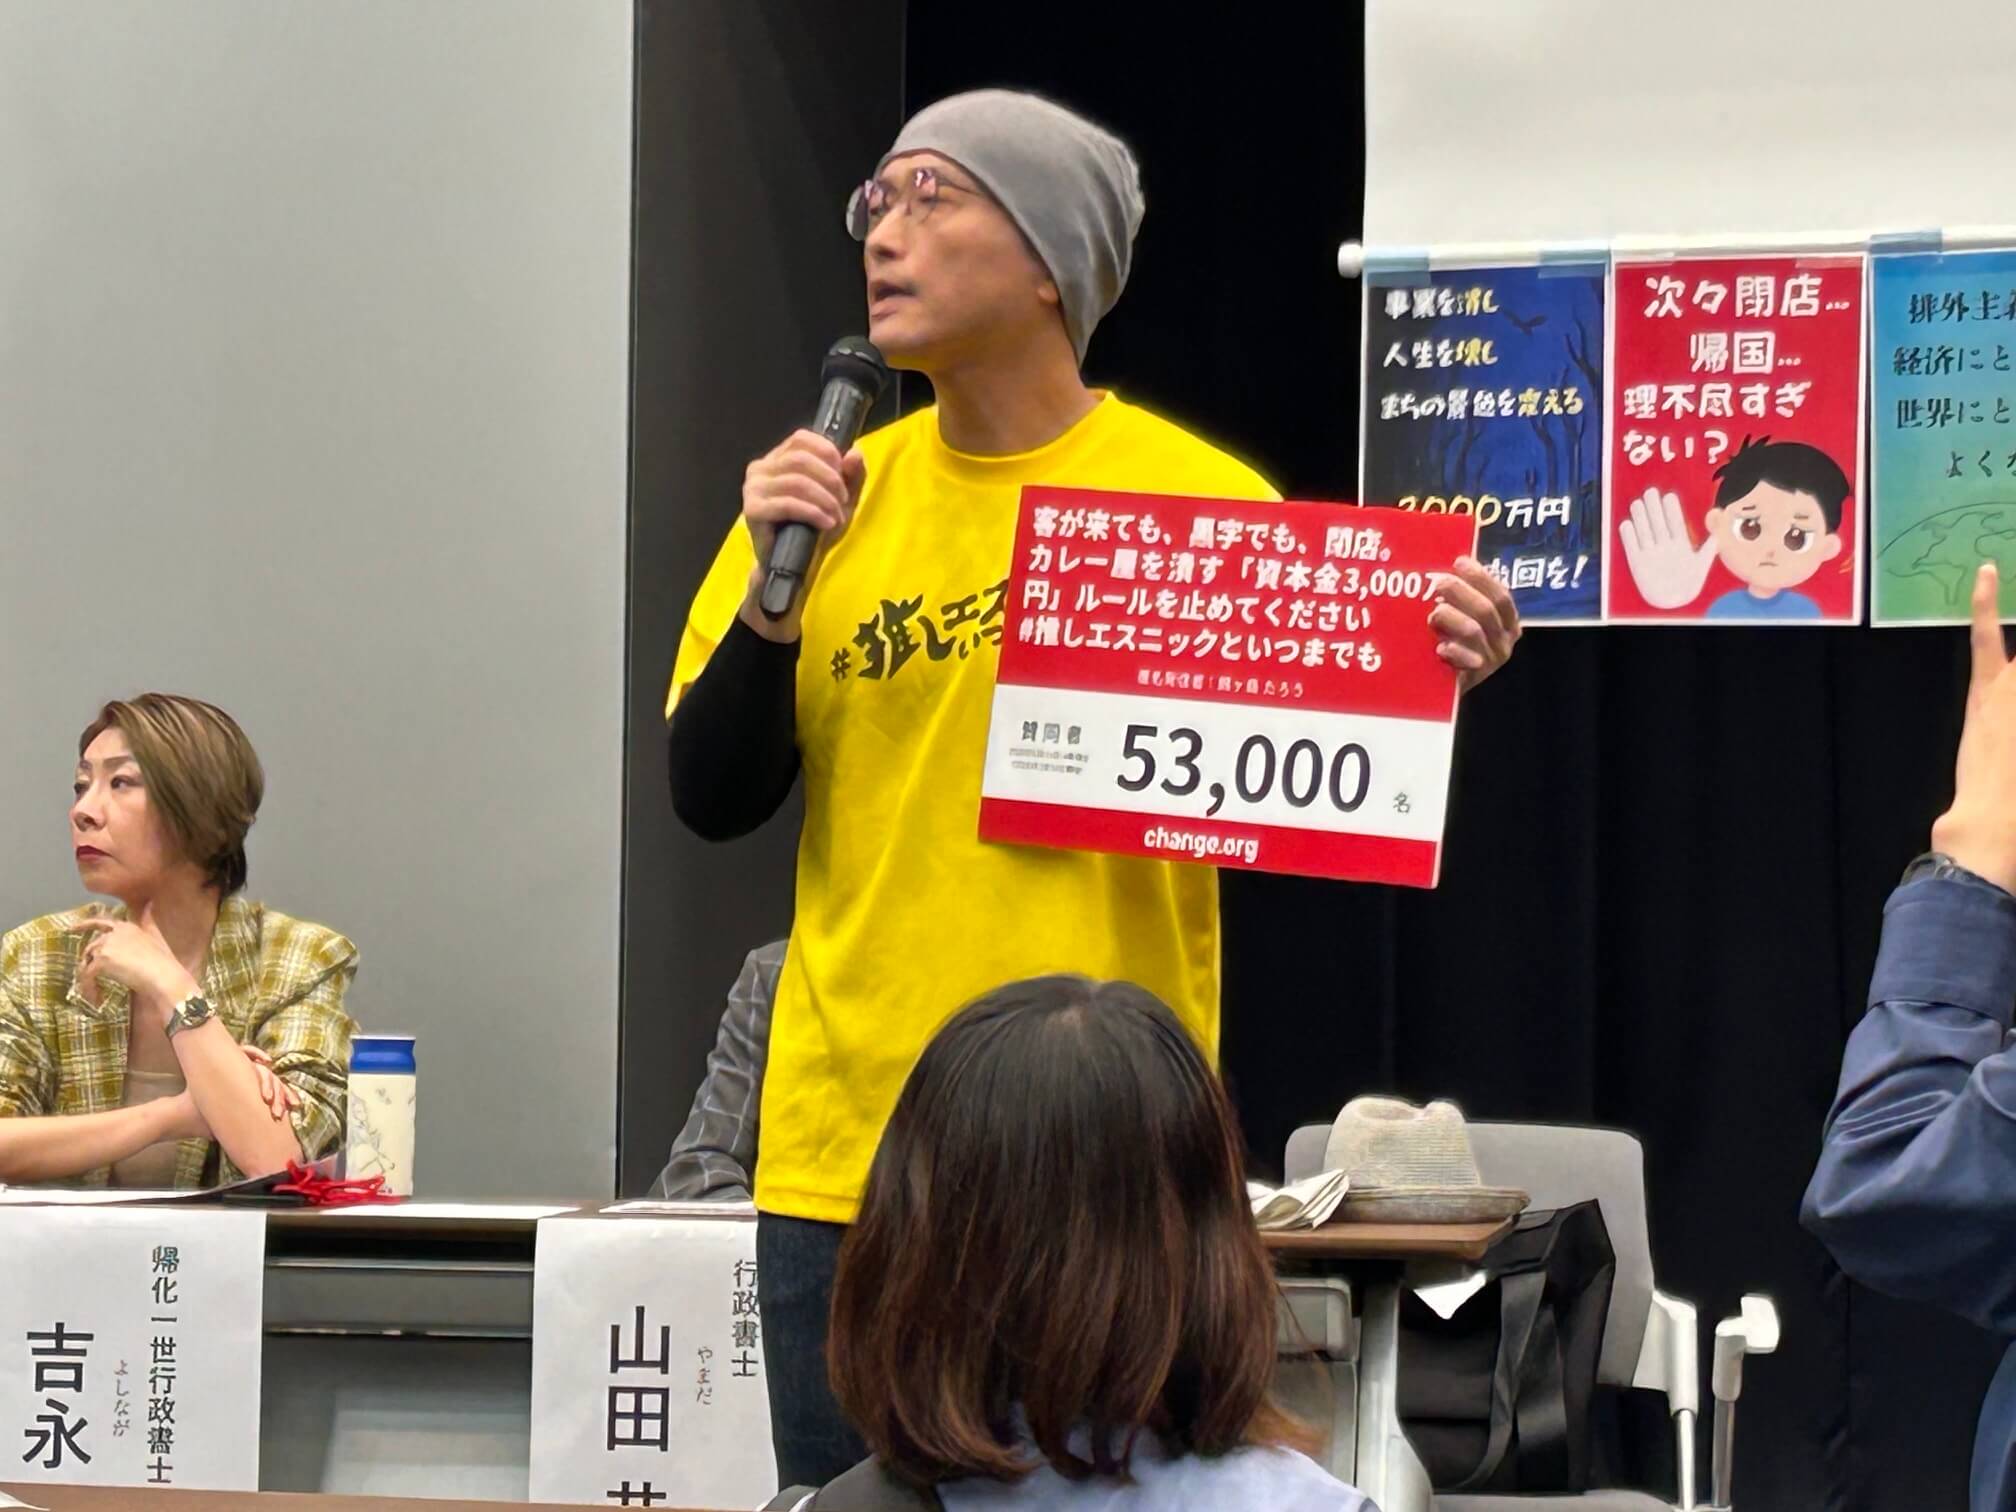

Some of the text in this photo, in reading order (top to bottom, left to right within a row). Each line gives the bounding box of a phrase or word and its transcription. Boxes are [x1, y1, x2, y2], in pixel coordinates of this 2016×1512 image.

[1893, 345, 2010, 376] 経済にと
[1380, 386, 1584, 420] まちの景色を変える
[1623, 380, 1812, 420] 理不尽すぎ
[1897, 397, 2010, 429] 世界にと
[1623, 429, 1729, 466] ない?
[1023, 579, 1372, 632] 円」ルールを止めてください
[1018, 614, 1382, 672] #推しエスニックといつまでも
[1117, 724, 1411, 817] 53,000 名
[1144, 826, 1259, 864] change.org
[731, 1259, 760, 1378] 行政書士
[147, 1244, 180, 1484] 帰化一世行政書士
[697, 1345, 713, 1406] やまだ
[22, 1321, 94, 1469] 吉永
[112, 1359, 130, 1438] よしなが
